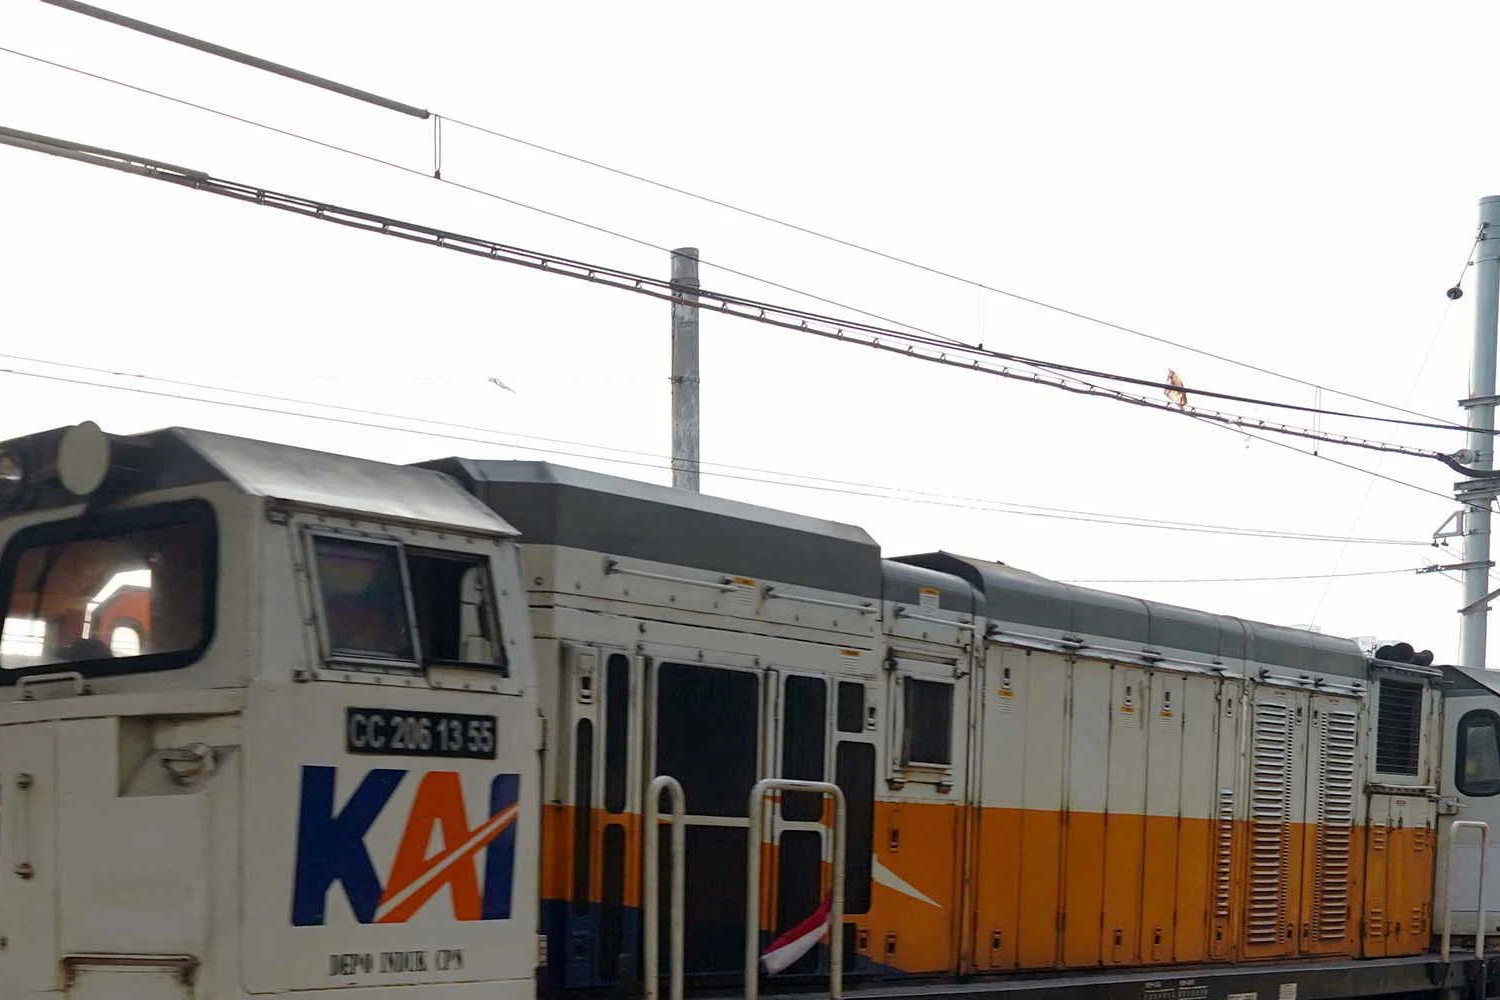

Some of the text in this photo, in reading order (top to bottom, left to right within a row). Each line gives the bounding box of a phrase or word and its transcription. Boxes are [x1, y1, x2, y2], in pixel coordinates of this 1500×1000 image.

[353, 714, 493, 752] CC 206 13 55
[291, 765, 521, 926] KAI
[329, 953, 374, 976] DEPO
[379, 950, 429, 974] INDUK
